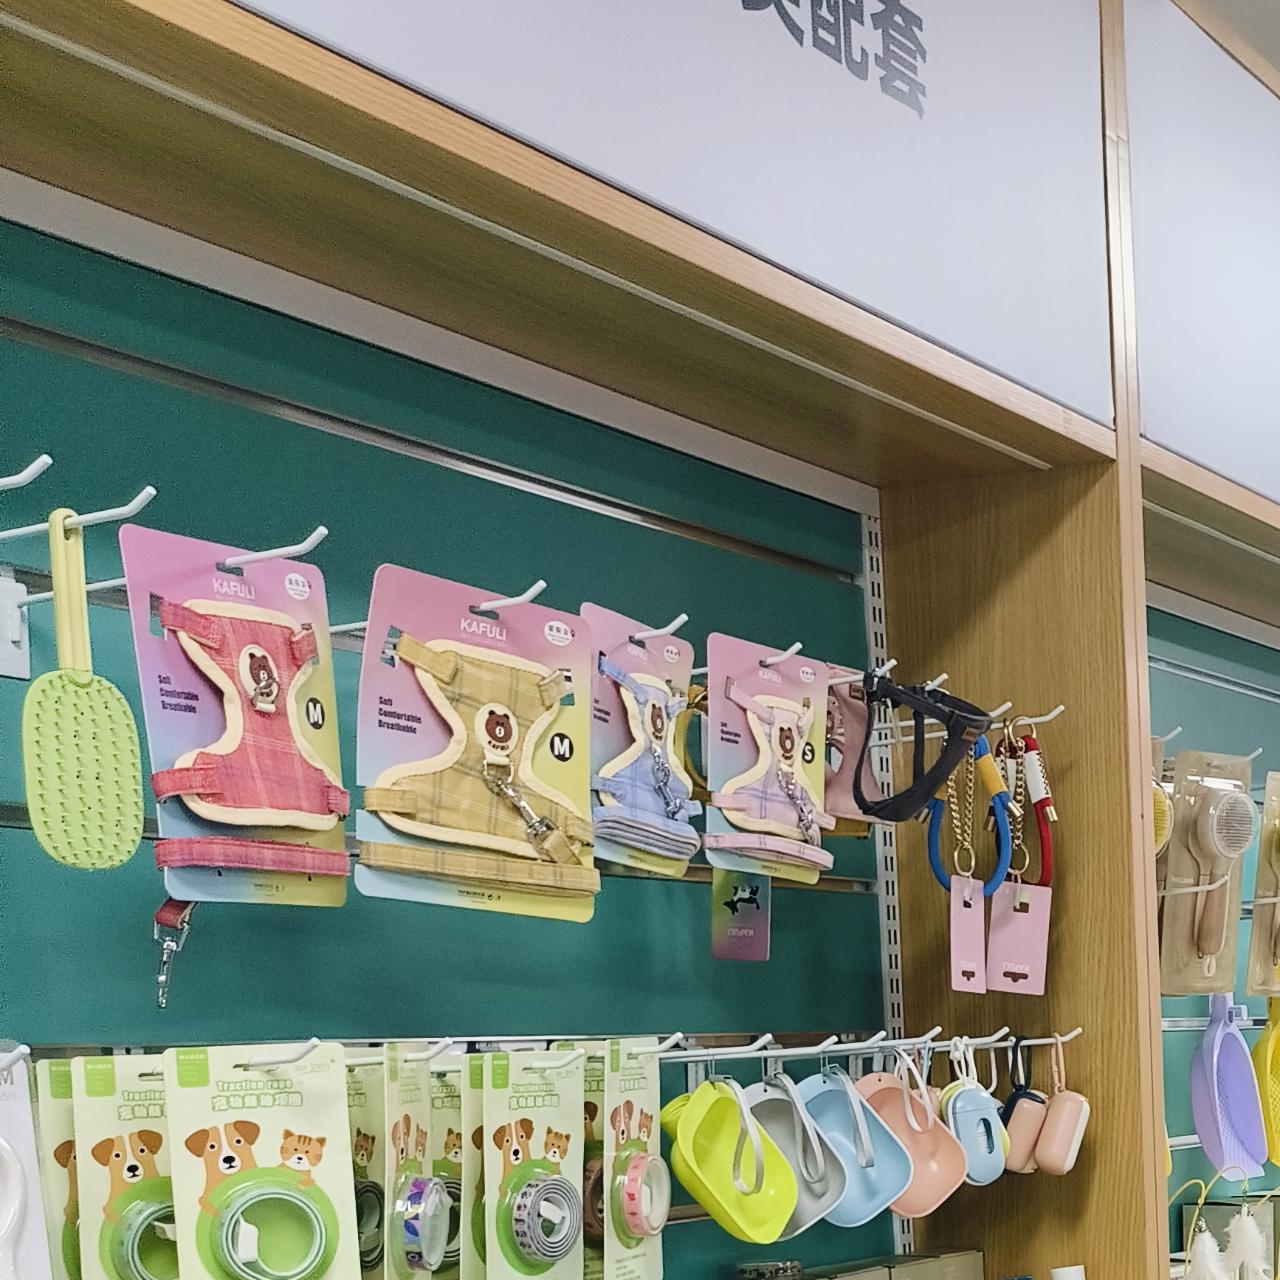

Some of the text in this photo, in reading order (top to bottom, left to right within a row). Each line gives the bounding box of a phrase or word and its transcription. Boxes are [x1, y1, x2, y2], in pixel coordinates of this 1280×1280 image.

[741, 0, 928, 120] 配套
[213, 578, 256, 600] KAFULI
[460, 618, 507, 641] KAFULI
[160, 687, 200, 702] Comfortable
[161, 700, 197, 714] Breathable
[309, 701, 322, 725] M
[378, 707, 423, 724] Comfortable
[377, 719, 418, 735] Breathable
[553, 736, 570, 758] M
[804, 745, 813, 761] S
[216, 1079, 293, 1092] Traction rope
